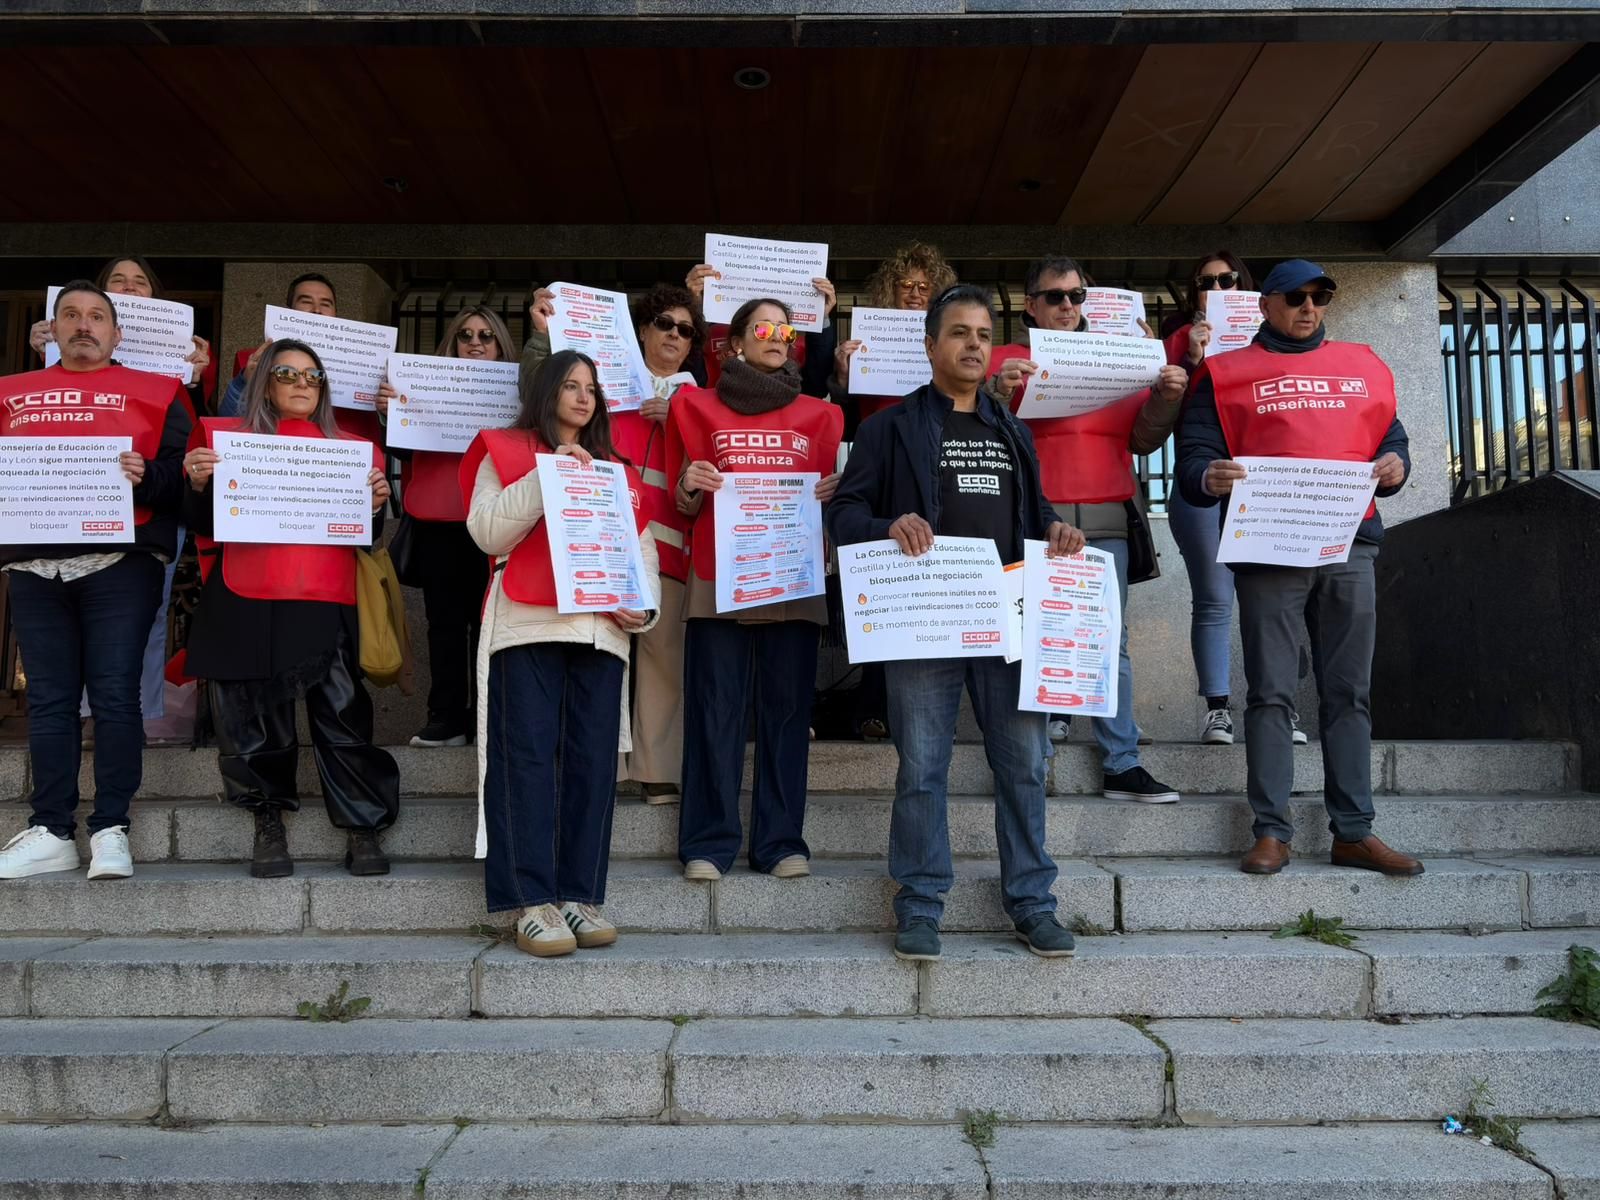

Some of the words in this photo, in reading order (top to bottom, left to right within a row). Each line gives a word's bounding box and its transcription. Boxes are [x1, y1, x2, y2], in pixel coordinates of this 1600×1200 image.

[727, 242, 763, 250] Consejería
[725, 262, 760, 270] bloqueada
[595, 294, 614, 303] INFORMA
[131, 302, 173, 313] Educación
[137, 316, 189, 326] manteniendo
[290, 316, 328, 328] Consejería
[340, 326, 376, 336] Educación
[126, 325, 174, 335] negociación
[345, 338, 390, 349] manteniendo
[1054, 337, 1093, 345] Consejería
[335, 346, 376, 356] negociación
[413, 361, 454, 370] Consejería
[466, 366, 505, 374] Educación
[1054, 358, 1092, 367] bloqueada
[411, 384, 451, 392] bloqueada
[1260, 380, 1330, 397] CCOO
[9, 391, 81, 410] CCOO
[1257, 398, 1346, 414] enseñanza
[10, 411, 94, 428] enseñanza
[716, 434, 782, 450] CCOO
[985, 440, 1007, 449] fren
[1, 444, 43, 452] onsejería
[244, 441, 290, 451] Consejería
[306, 445, 349, 454] Educación
[287, 457, 310, 465] sigue
[312, 460, 366, 468] manteniendo
[718, 453, 793, 470] enseñanza
[980, 460, 1013, 470] importa
[52, 469, 106, 477] negociación
[242, 467, 288, 476] bloqueada
[595, 465, 614, 474] INFORMA
[1258, 465, 1299, 474] Consejería
[1313, 467, 1356, 476] Educación
[1358, 471, 1370, 479] de
[960, 477, 996, 486] CCOO
[959, 487, 1000, 495] enseñanza
[1303, 494, 1354, 502] negociación
[280, 522, 315, 530] bloquear
[1271, 519, 1329, 527] reivindicaciones
[868, 547, 905, 557] Consej
[934, 544, 975, 552] Educación
[1274, 544, 1310, 552] bloquear
[1086, 554, 1105, 564] INFORMA
[850, 564, 884, 574] Castilla
[893, 560, 914, 568] León
[917, 559, 940, 567] sigue
[870, 574, 920, 585] bloqueada
[933, 572, 982, 581] negociación
[855, 607, 889, 616] negociar
[886, 620, 928, 629] momento
[916, 634, 950, 642] bloquear
